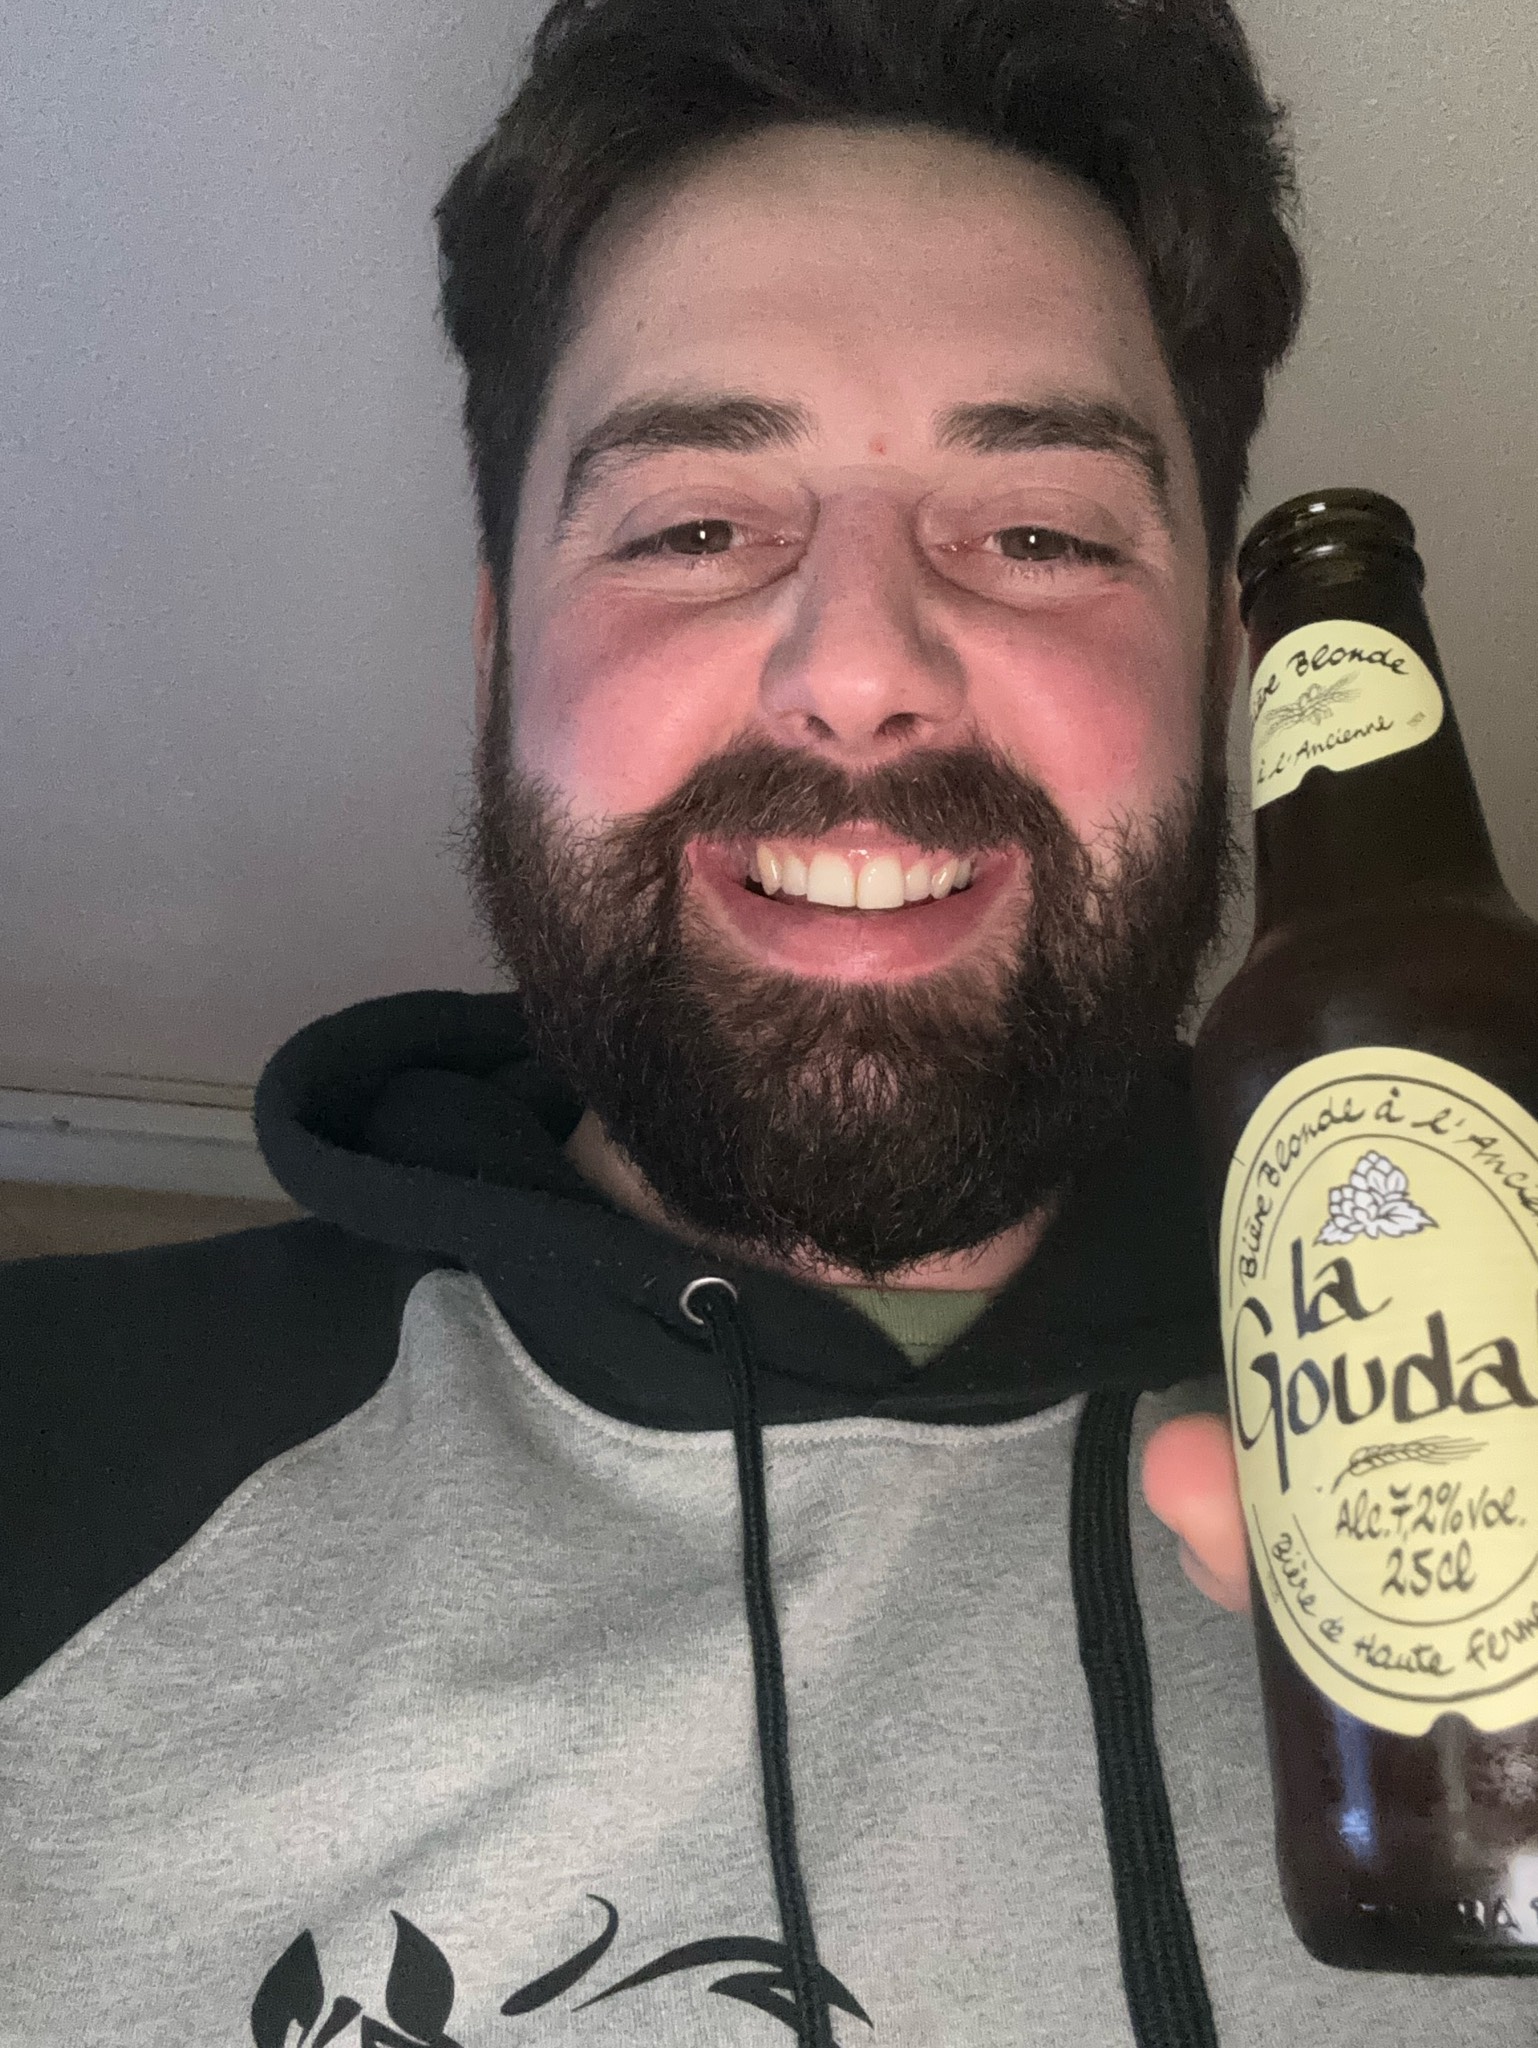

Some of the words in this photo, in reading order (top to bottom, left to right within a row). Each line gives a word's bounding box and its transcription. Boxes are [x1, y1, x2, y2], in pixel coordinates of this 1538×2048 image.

[1285, 643, 1409, 677] Blonde
[1267, 714, 1395, 780] l'Ancienne
[1256, 1095, 1366, 1189] Blonde
[1374, 1086, 1405, 1123] à
[1410, 1107, 1538, 1218] l'Ancie
[1239, 1193, 1274, 1288] Bière
[1232, 1296, 1538, 1496] Gouda
[1270, 1531, 1318, 1618] Bière
[1318, 1615, 1345, 1644] de
[1353, 1632, 1456, 1678] Haute
